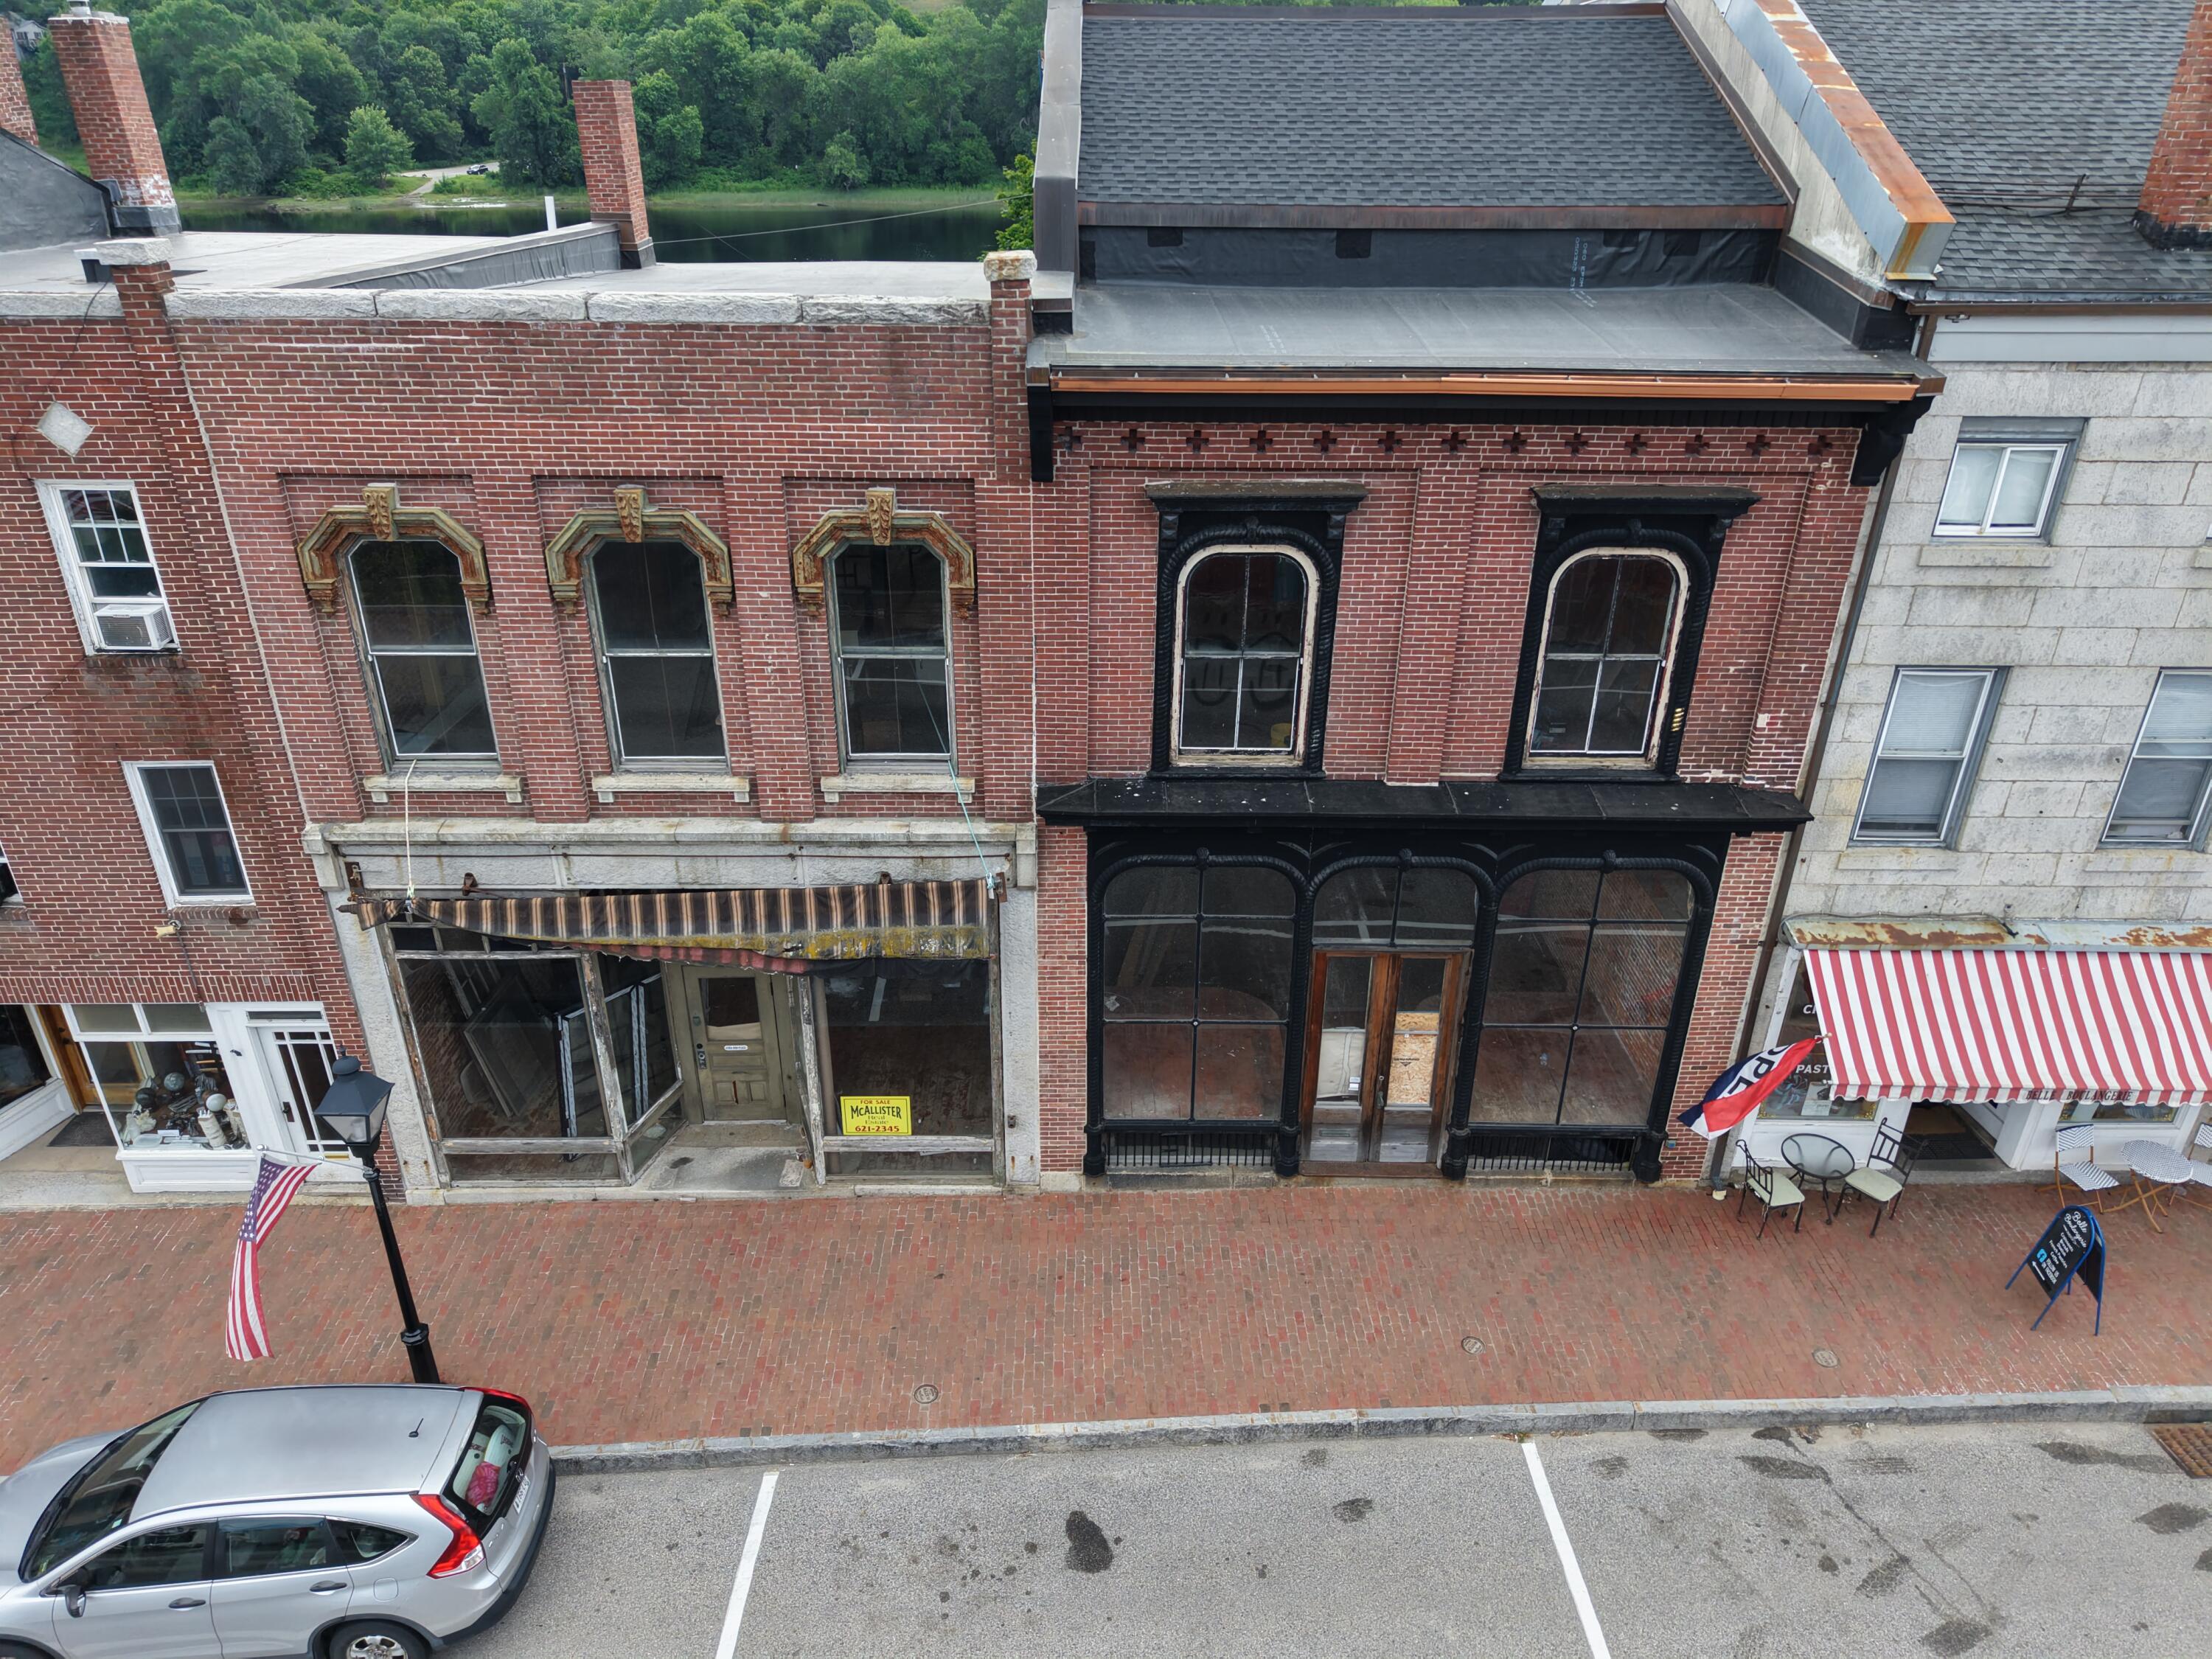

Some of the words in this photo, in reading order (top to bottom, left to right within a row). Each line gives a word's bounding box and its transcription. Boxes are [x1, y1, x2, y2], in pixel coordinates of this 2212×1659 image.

[2025, 1091, 2058, 1100] BELLE
[2066, 1091, 2133, 1101] BOULANGERIE
[2065, 1214, 2087, 1248] Boulangerie
[2073, 1211, 2087, 1233] Belle
